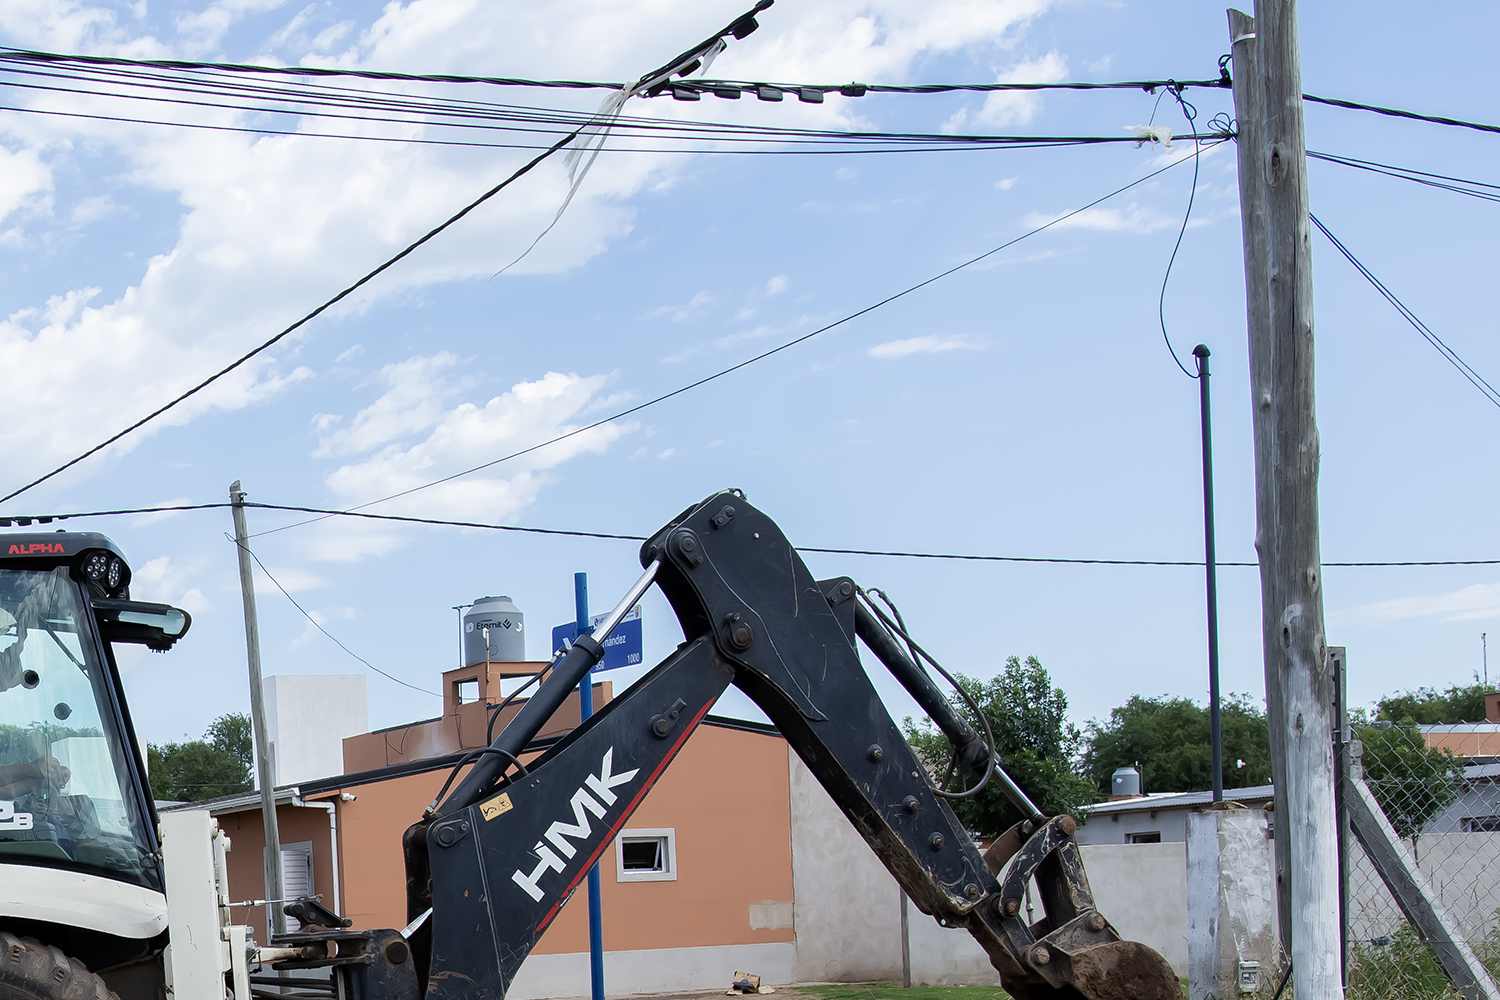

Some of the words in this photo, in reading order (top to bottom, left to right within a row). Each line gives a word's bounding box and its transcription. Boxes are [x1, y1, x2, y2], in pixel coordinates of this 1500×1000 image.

[8, 543, 65, 555] ALPHA
[627, 652, 640, 664] 1000
[511, 745, 640, 903] HMK
